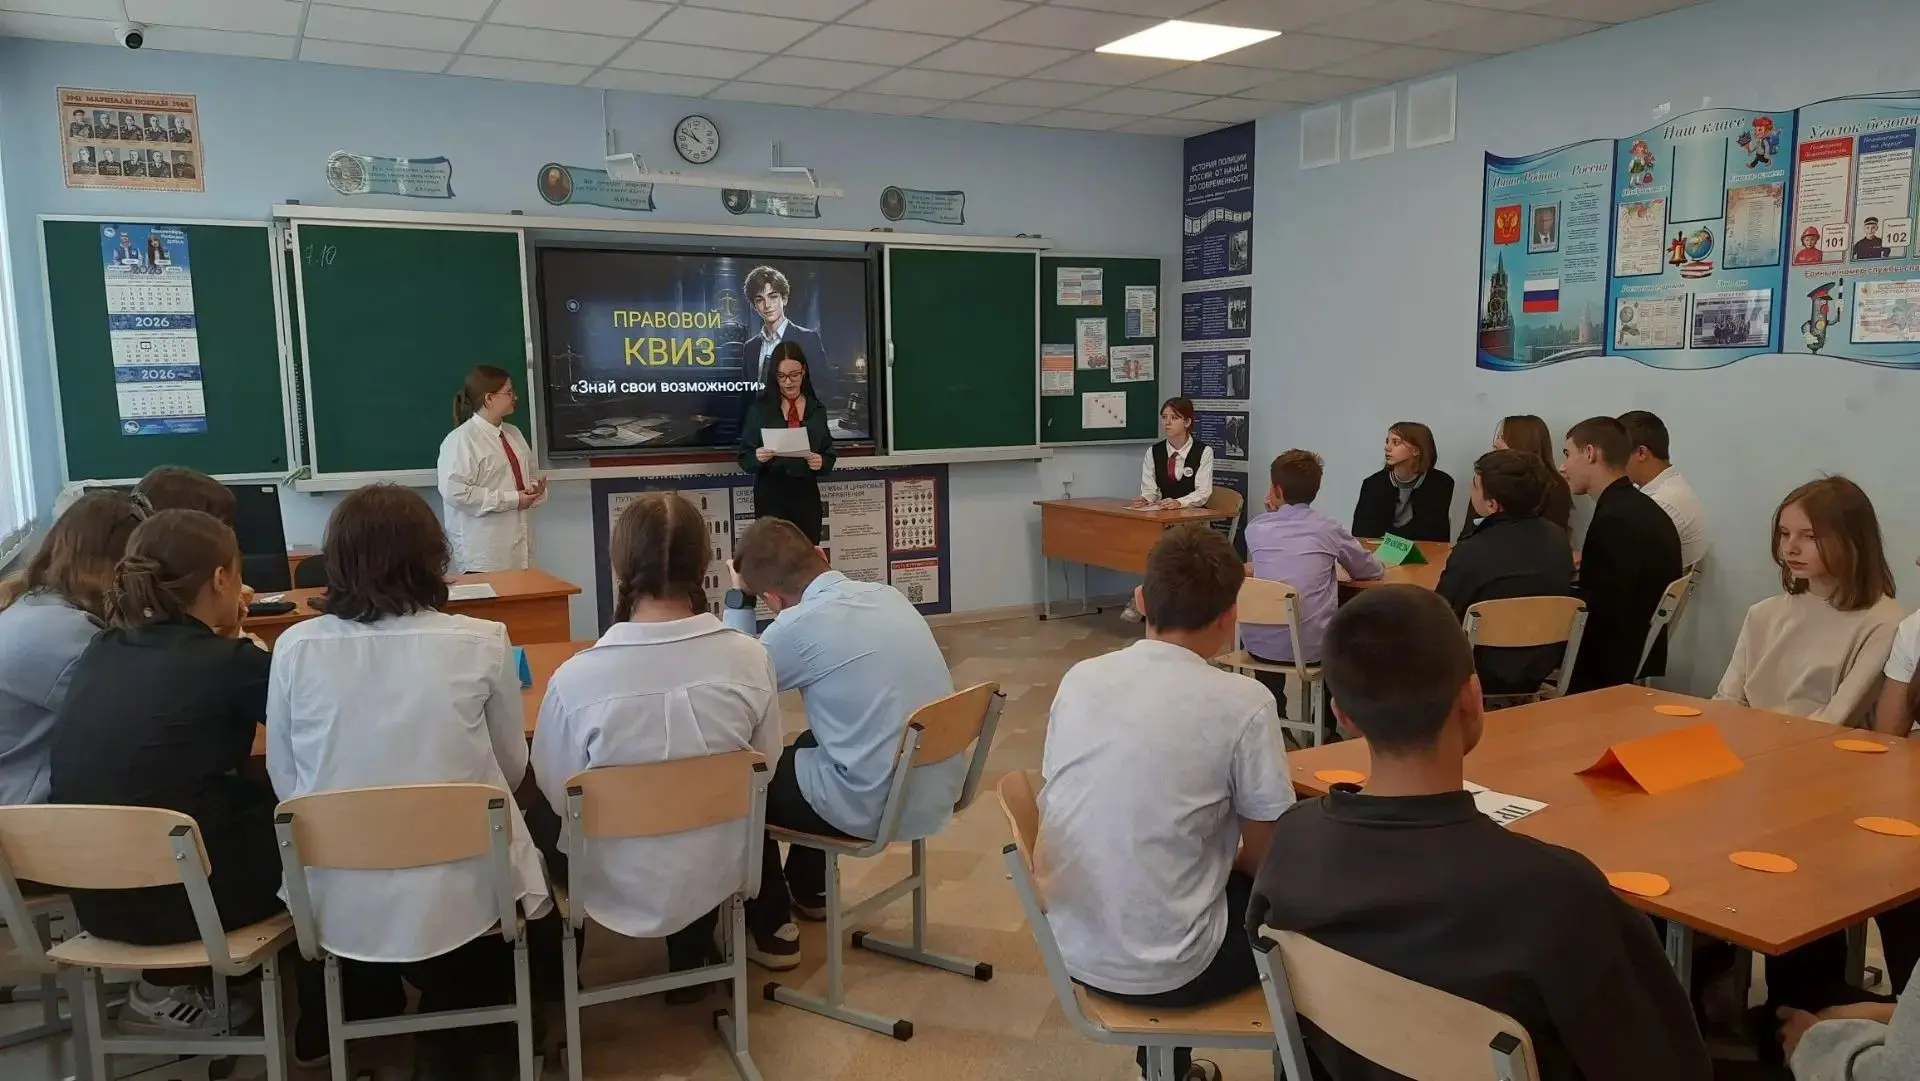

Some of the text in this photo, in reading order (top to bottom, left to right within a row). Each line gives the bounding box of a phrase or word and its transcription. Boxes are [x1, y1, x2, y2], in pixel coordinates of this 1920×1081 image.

[1663, 117, 1745, 140] Наш класс
[1809, 125, 1861, 138] Уголок
[1192, 153, 1248, 172] ИСТОРИЯ ПОЛИЦИИ
[1572, 162, 1608, 176] Россия
[1224, 164, 1248, 175] НАЧАЛА
[1198, 173, 1249, 190] СОВРЕМЕННОСТИ
[1825, 237, 1844, 248] 101
[1886, 232, 1907, 243] 102
[132, 264, 162, 275] 2026
[1804, 270, 1837, 278] Единый
[1838, 268, 1866, 276] номер
[1867, 265, 1902, 275] службы
[136, 317, 170, 328] 2026
[613, 308, 721, 329] ПРАВОВОЙ
[624, 336, 716, 367] КВИЗ
[141, 369, 176, 380] 2026
[570, 379, 766, 394] «Знай свои возможности»
[850, 481, 884, 491] ЦИФРОВЫЕ
